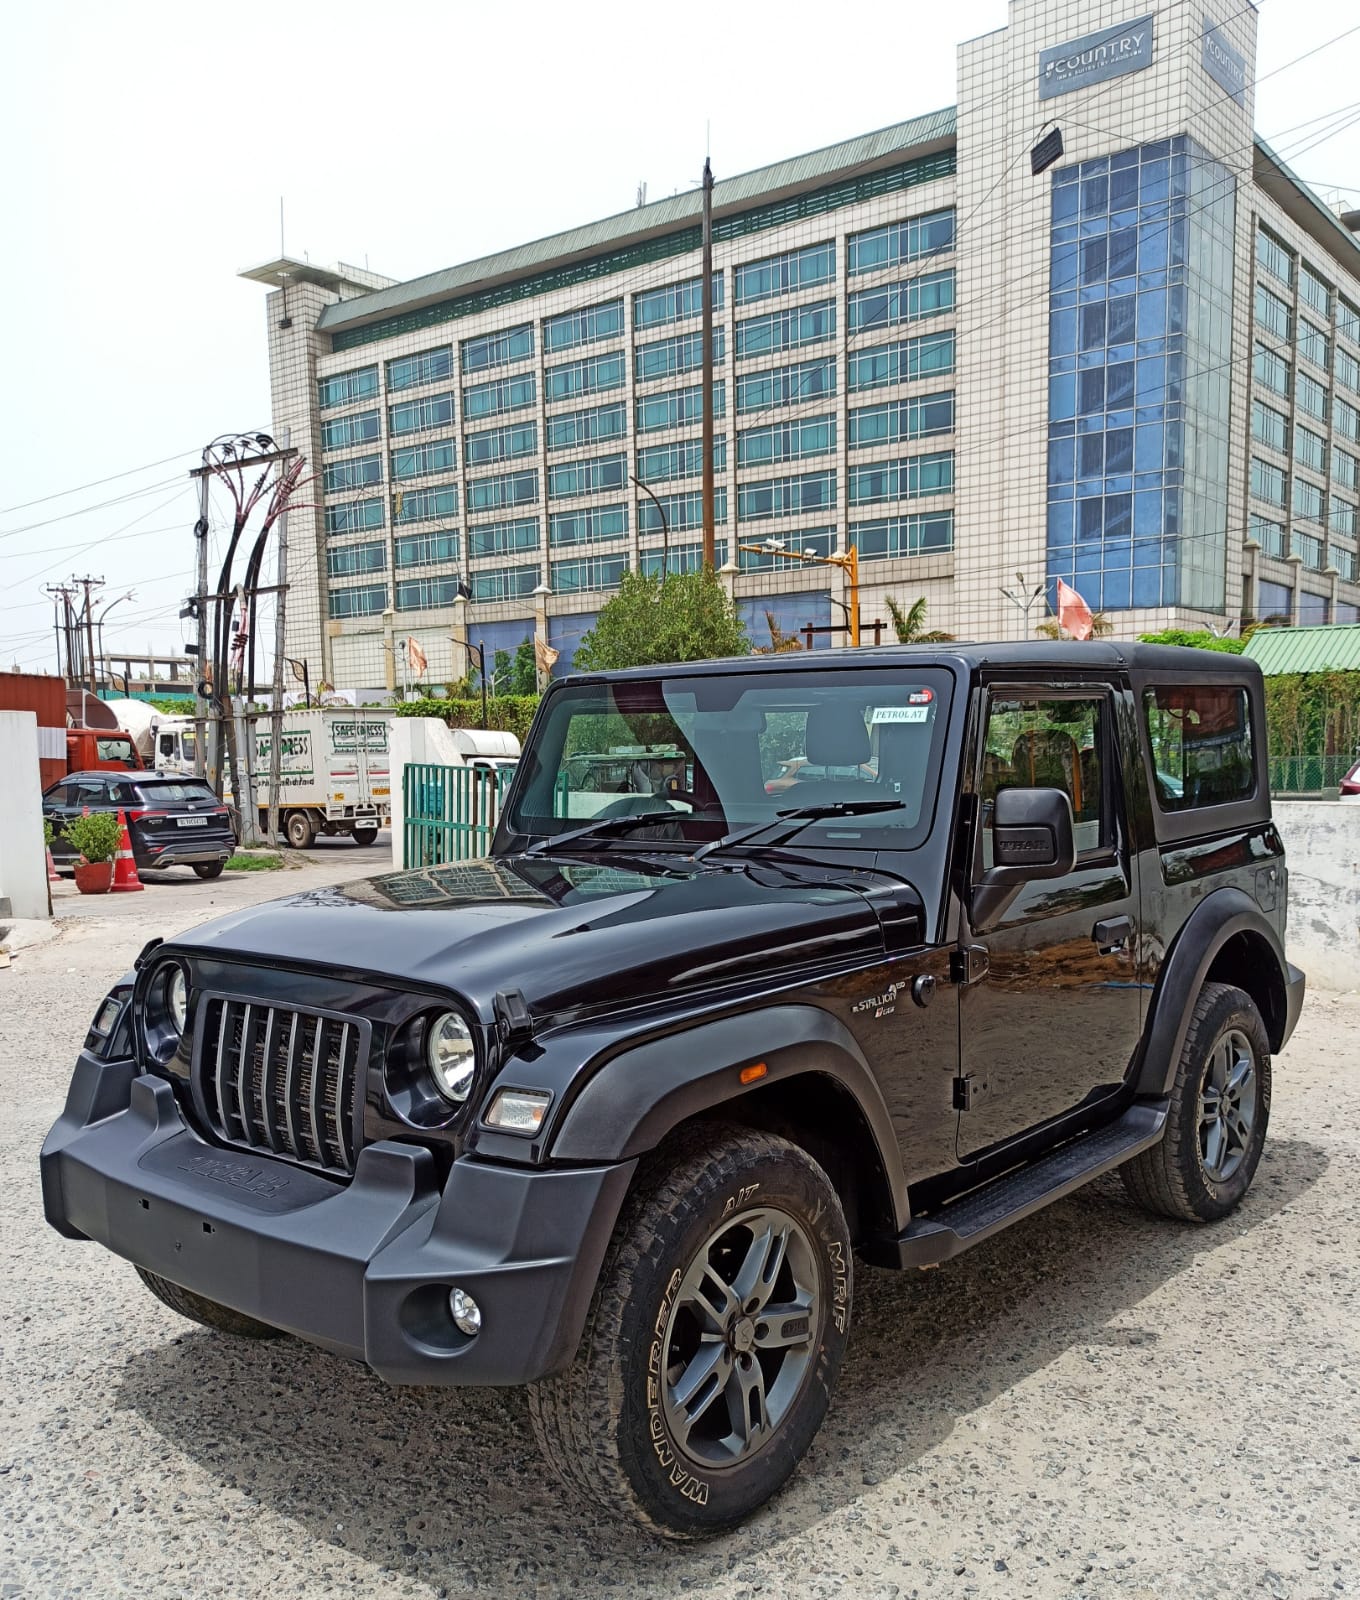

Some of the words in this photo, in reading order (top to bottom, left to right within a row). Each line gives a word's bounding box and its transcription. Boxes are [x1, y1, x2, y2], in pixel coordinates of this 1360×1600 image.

[1055, 33, 1145, 73] COUNTRY
[876, 710, 909, 719] PETROL
[910, 710, 924, 718] AT
[827, 1241, 850, 1336] MRF
[647, 1267, 709, 1506] WANDERER
